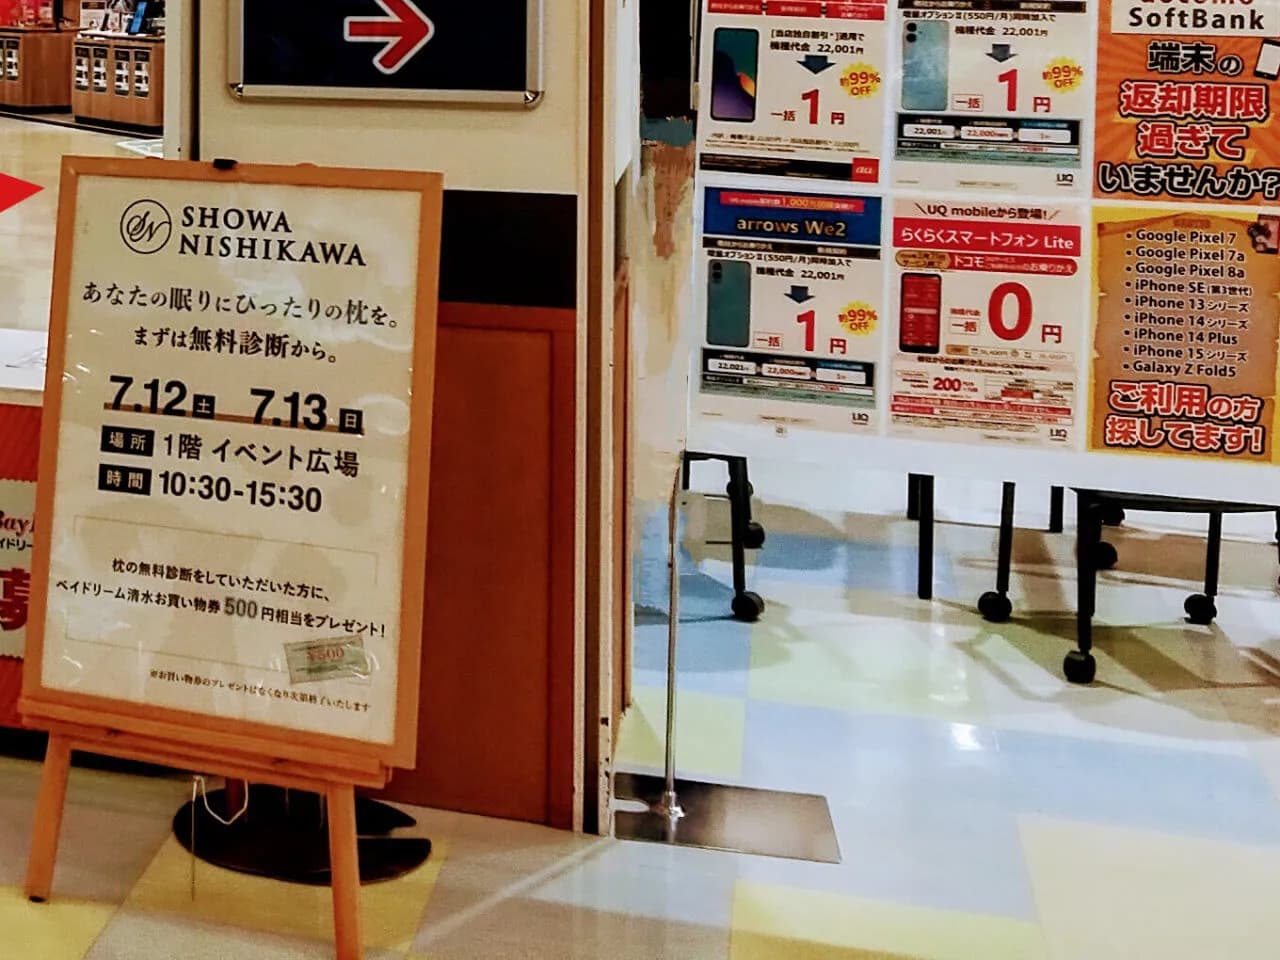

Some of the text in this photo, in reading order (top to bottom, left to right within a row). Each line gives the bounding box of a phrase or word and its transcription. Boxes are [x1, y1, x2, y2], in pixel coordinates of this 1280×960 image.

[1129, 7, 1265, 31] SoftBank
[1147, 41, 1242, 75] 端末の
[998, 68, 1018, 112] 1
[1033, 97, 1050, 112] 円
[1120, 82, 1267, 120] 返却期限
[801, 89, 819, 125] 1
[1136, 122, 1247, 159] 過ぎて
[1098, 162, 1280, 200] いませんか?
[182, 206, 293, 233] SHOWA
[927, 205, 947, 217] UQ
[737, 219, 847, 237] arrows We2
[1136, 229, 1237, 245] Google Pixel 7
[178, 234, 367, 267] NISHIKAWA
[1044, 236, 1074, 249] Lite
[1135, 246, 1245, 262] Google Pixel 7a
[1135, 262, 1245, 279] Google Pixel 8a
[1135, 279, 1185, 293] iPhone
[988, 282, 1033, 341] 0
[1041, 324, 1062, 343] 円
[1135, 295, 1185, 309] iPhone
[1134, 312, 1184, 326] iPhone
[133, 326, 337, 363] まずは無料診断から。
[797, 310, 816, 352] 1
[829, 338, 847, 354] 円
[1134, 328, 1238, 346] iPhone 14 Plus
[1133, 345, 1183, 359] iPhone
[1133, 361, 1237, 378] Galaxy Z Fold5
[1110, 381, 1261, 421] ご利用の方
[108, 430, 148, 450] 場所
[1107, 415, 1263, 454] 探してます!
[105, 469, 322, 513] 時間 10:30-15:30
